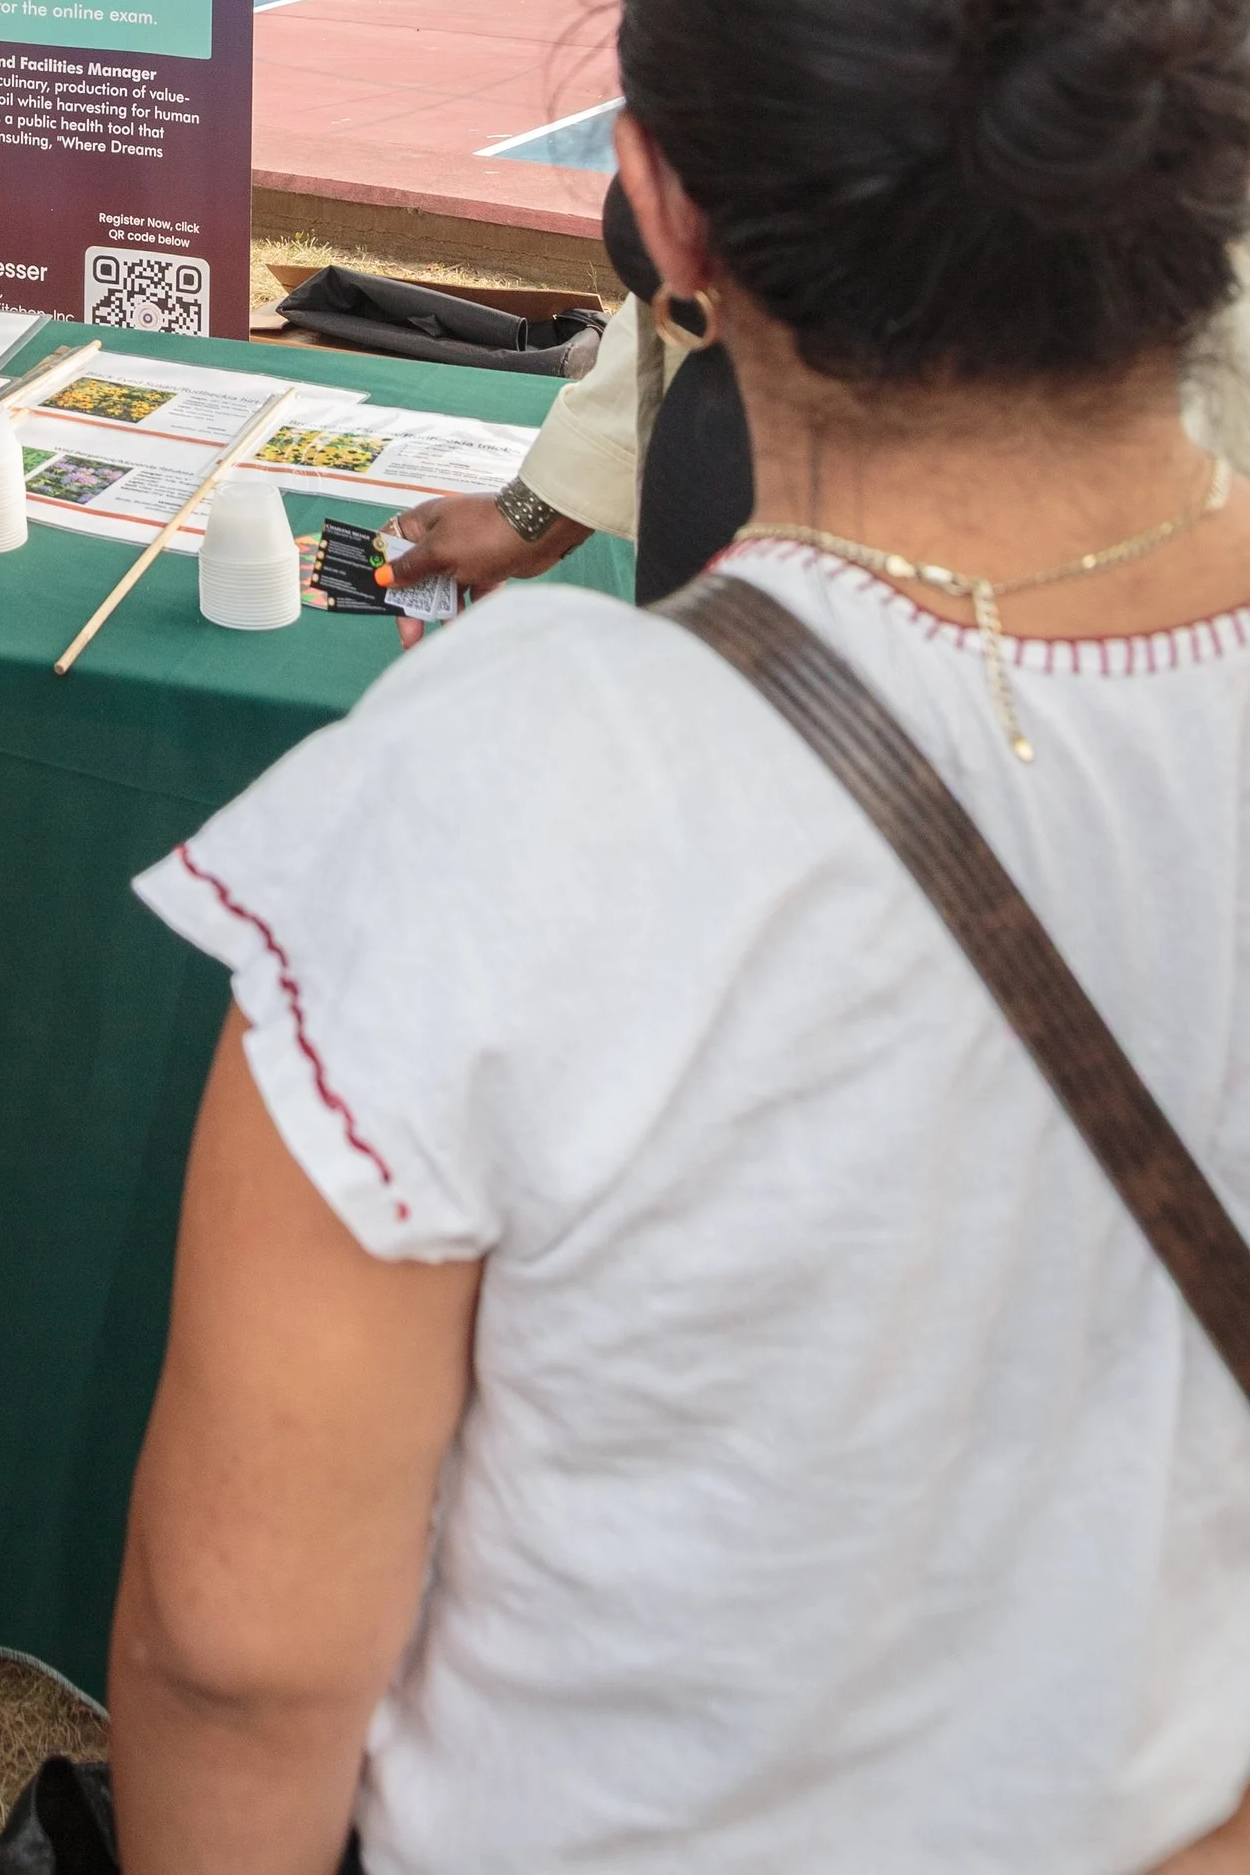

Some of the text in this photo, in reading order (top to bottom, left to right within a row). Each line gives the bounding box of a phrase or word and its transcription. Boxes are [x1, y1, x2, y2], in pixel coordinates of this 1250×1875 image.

[22, 0, 47, 16] the
[53, 3, 104, 20] online
[110, 11, 157, 25] exam.
[21, 57, 83, 74] Facilities
[88, 63, 157, 82] Manager
[55, 81, 127, 97] production
[132, 85, 146, 98] of
[150, 88, 190, 103] value-
[111, 140, 163, 157] Dreams
[99, 213, 199, 233] Register Now, click
[109, 229, 190, 247] QR code below
